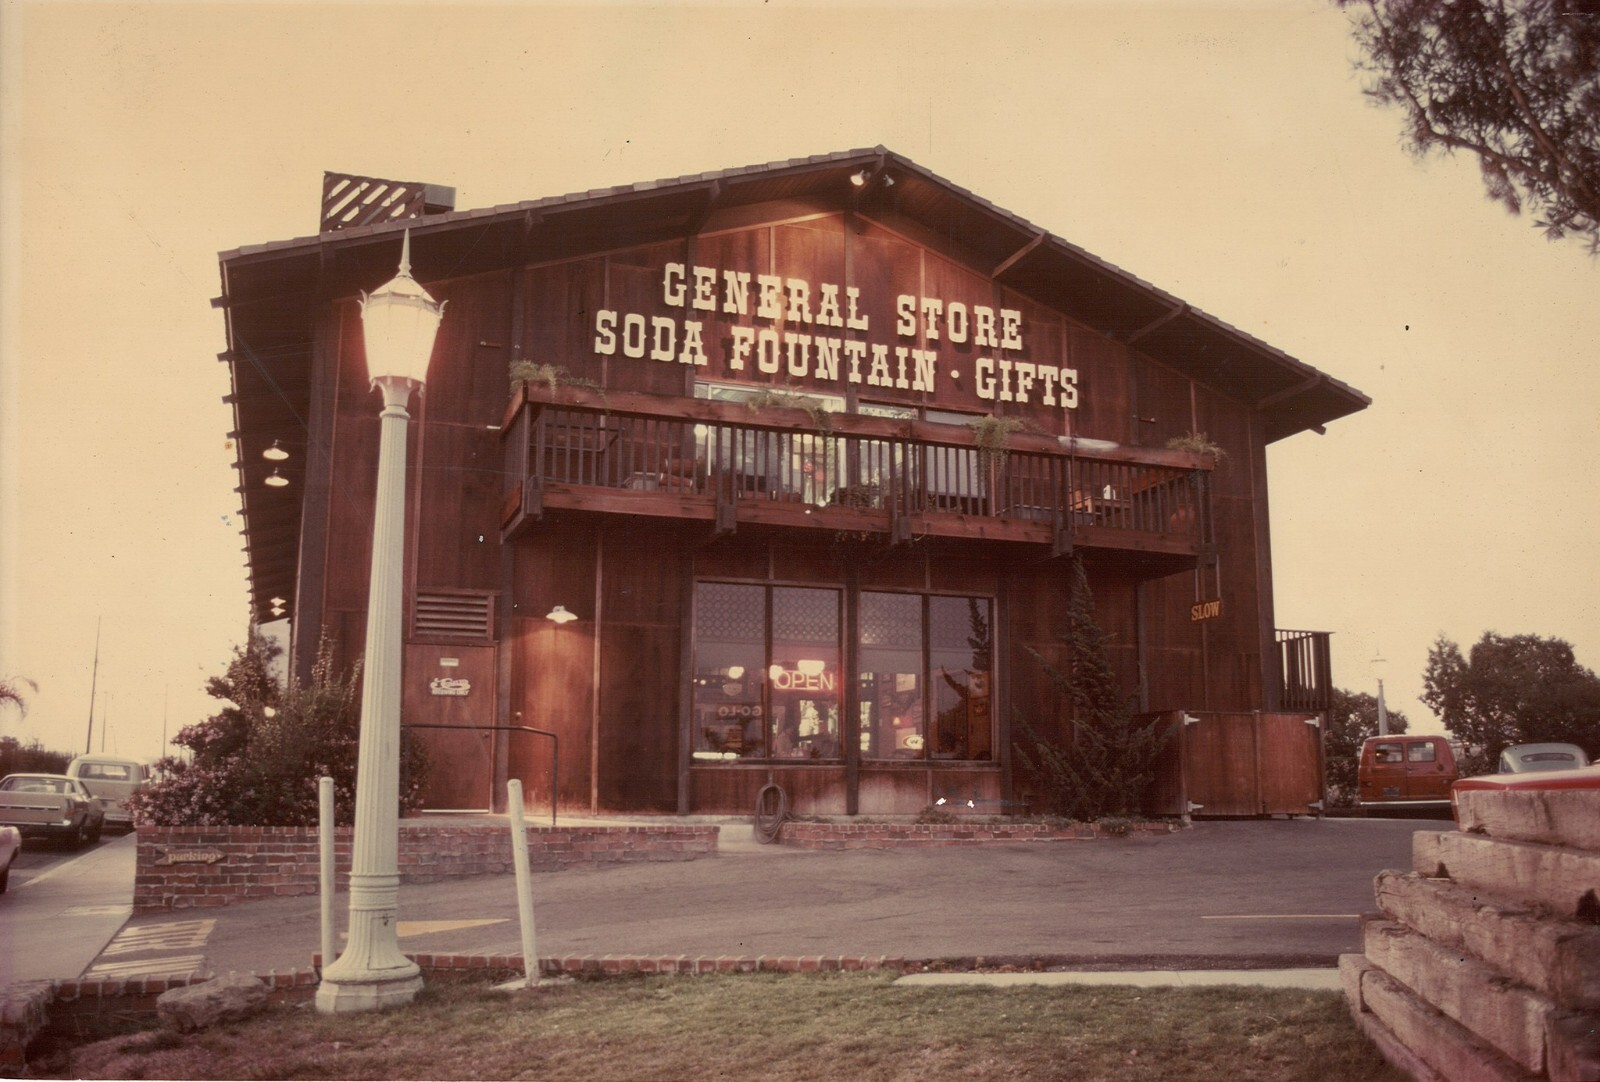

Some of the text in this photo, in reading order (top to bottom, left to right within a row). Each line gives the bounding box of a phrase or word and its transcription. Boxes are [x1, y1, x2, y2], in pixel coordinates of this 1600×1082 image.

[663, 262, 1023, 350] GENERAL STORE
[594, 310, 1079, 409] SODA FOUNTAIN GIFTS
[1191, 601, 1220, 620] SLOW
[776, 671, 834, 690] OPEN
[168, 851, 216, 864] parking
